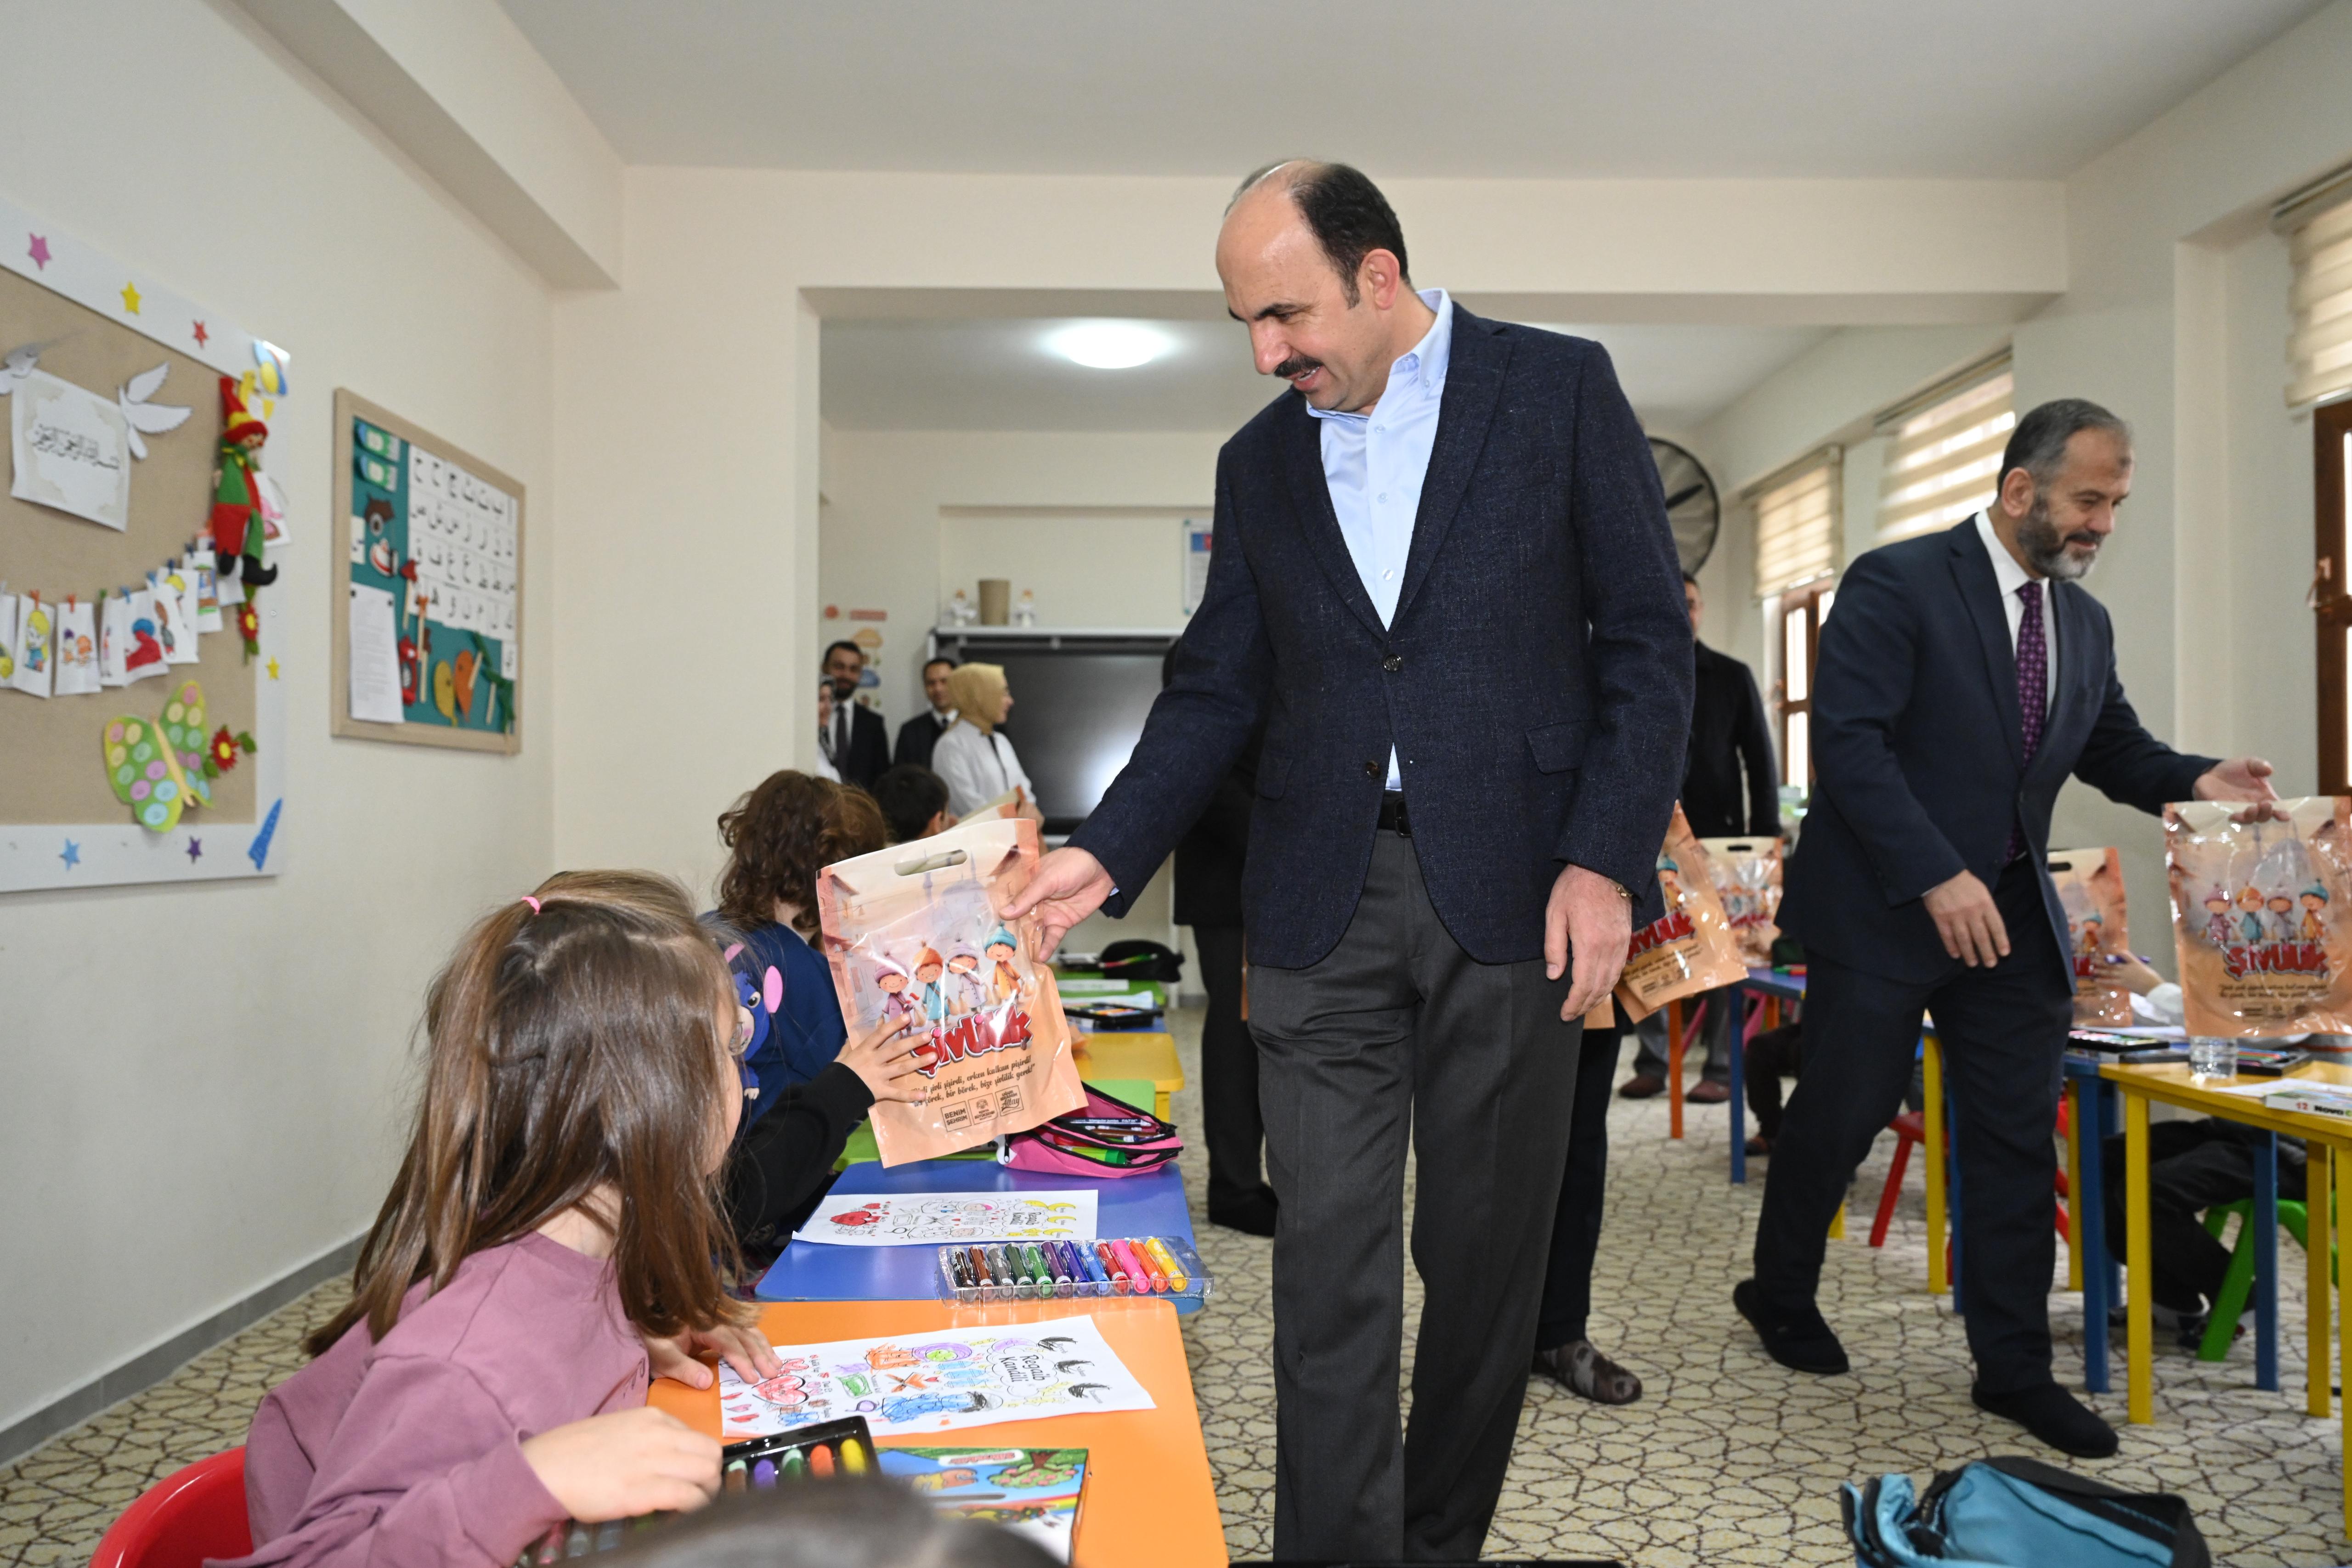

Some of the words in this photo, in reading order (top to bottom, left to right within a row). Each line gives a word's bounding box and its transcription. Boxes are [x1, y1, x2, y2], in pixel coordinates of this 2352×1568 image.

[967, 1069, 985, 1082] erken
[987, 1064, 1009, 1076] kalkan
[946, 1089, 956, 1099] bir
[958, 1084, 978, 1094] börek,
[980, 1078, 992, 1089] bize
[944, 1108, 966, 1119] BENİM
[946, 1115, 968, 1126] ŞEHRİM
[1010, 1212, 1025, 1225] Kandili
[1025, 1212, 1042, 1226] Regaib
[999, 1357, 1029, 1382] Kandili
[1020, 1354, 1050, 1381] Regaib
